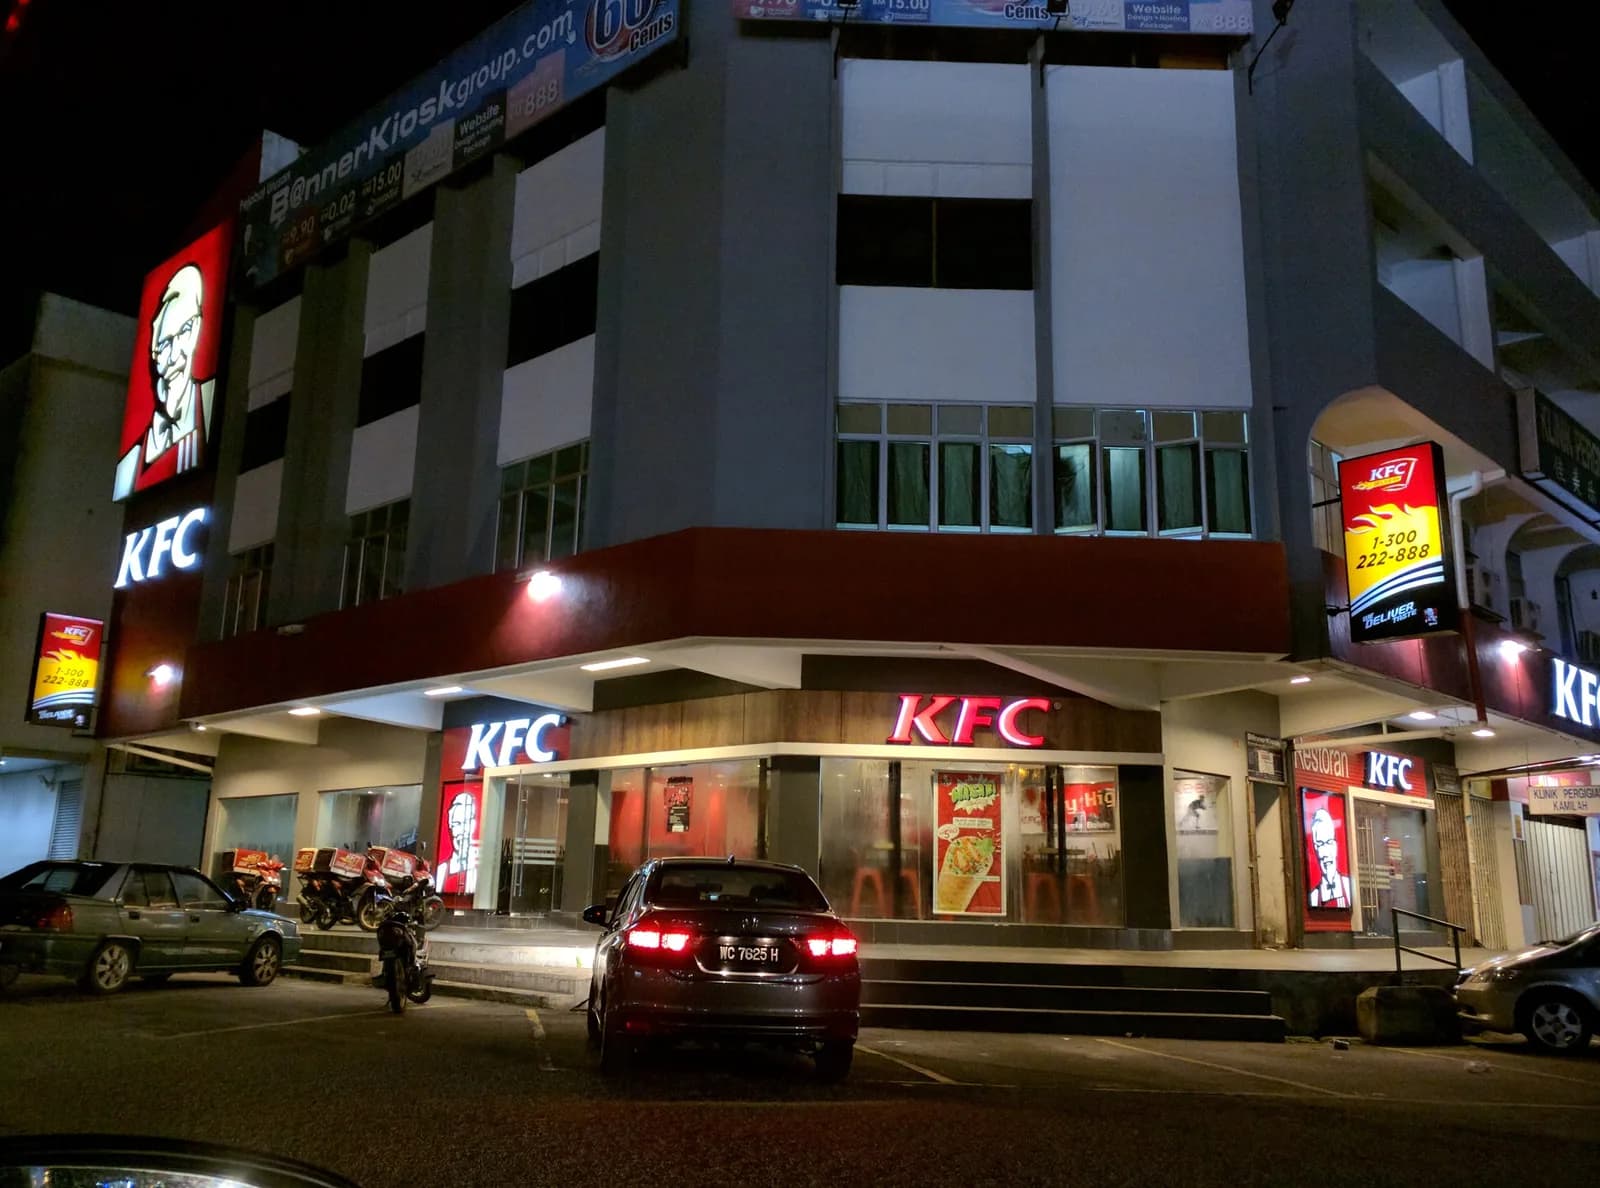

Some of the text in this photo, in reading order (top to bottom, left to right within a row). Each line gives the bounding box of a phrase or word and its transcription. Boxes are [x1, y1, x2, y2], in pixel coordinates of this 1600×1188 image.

[1005, 4, 1049, 19] Cents
[1132, 4, 1182, 14] Website
[1215, 15, 1250, 30] 888
[629, 12, 674, 53] Cents
[524, 82, 559, 115] 888
[459, 104, 501, 136] Website
[1369, 462, 1408, 481] KFC
[113, 508, 206, 589] KFC
[1373, 530, 1417, 549] 1-300
[1356, 544, 1430, 569] 222-888
[1364, 601, 1415, 629] DELIVER
[63, 626, 89, 637] KFC
[43, 675, 89, 688] 222-888
[887, 693, 1050, 747] KFC
[461, 713, 562, 772] KFC
[1294, 740, 1350, 778] Restoran
[1368, 751, 1413, 790] KFC
[1533, 788, 1557, 799] KLINIK
[1553, 800, 1588, 811] KAMILAH
[719, 946, 779, 962] WC 7625 H
